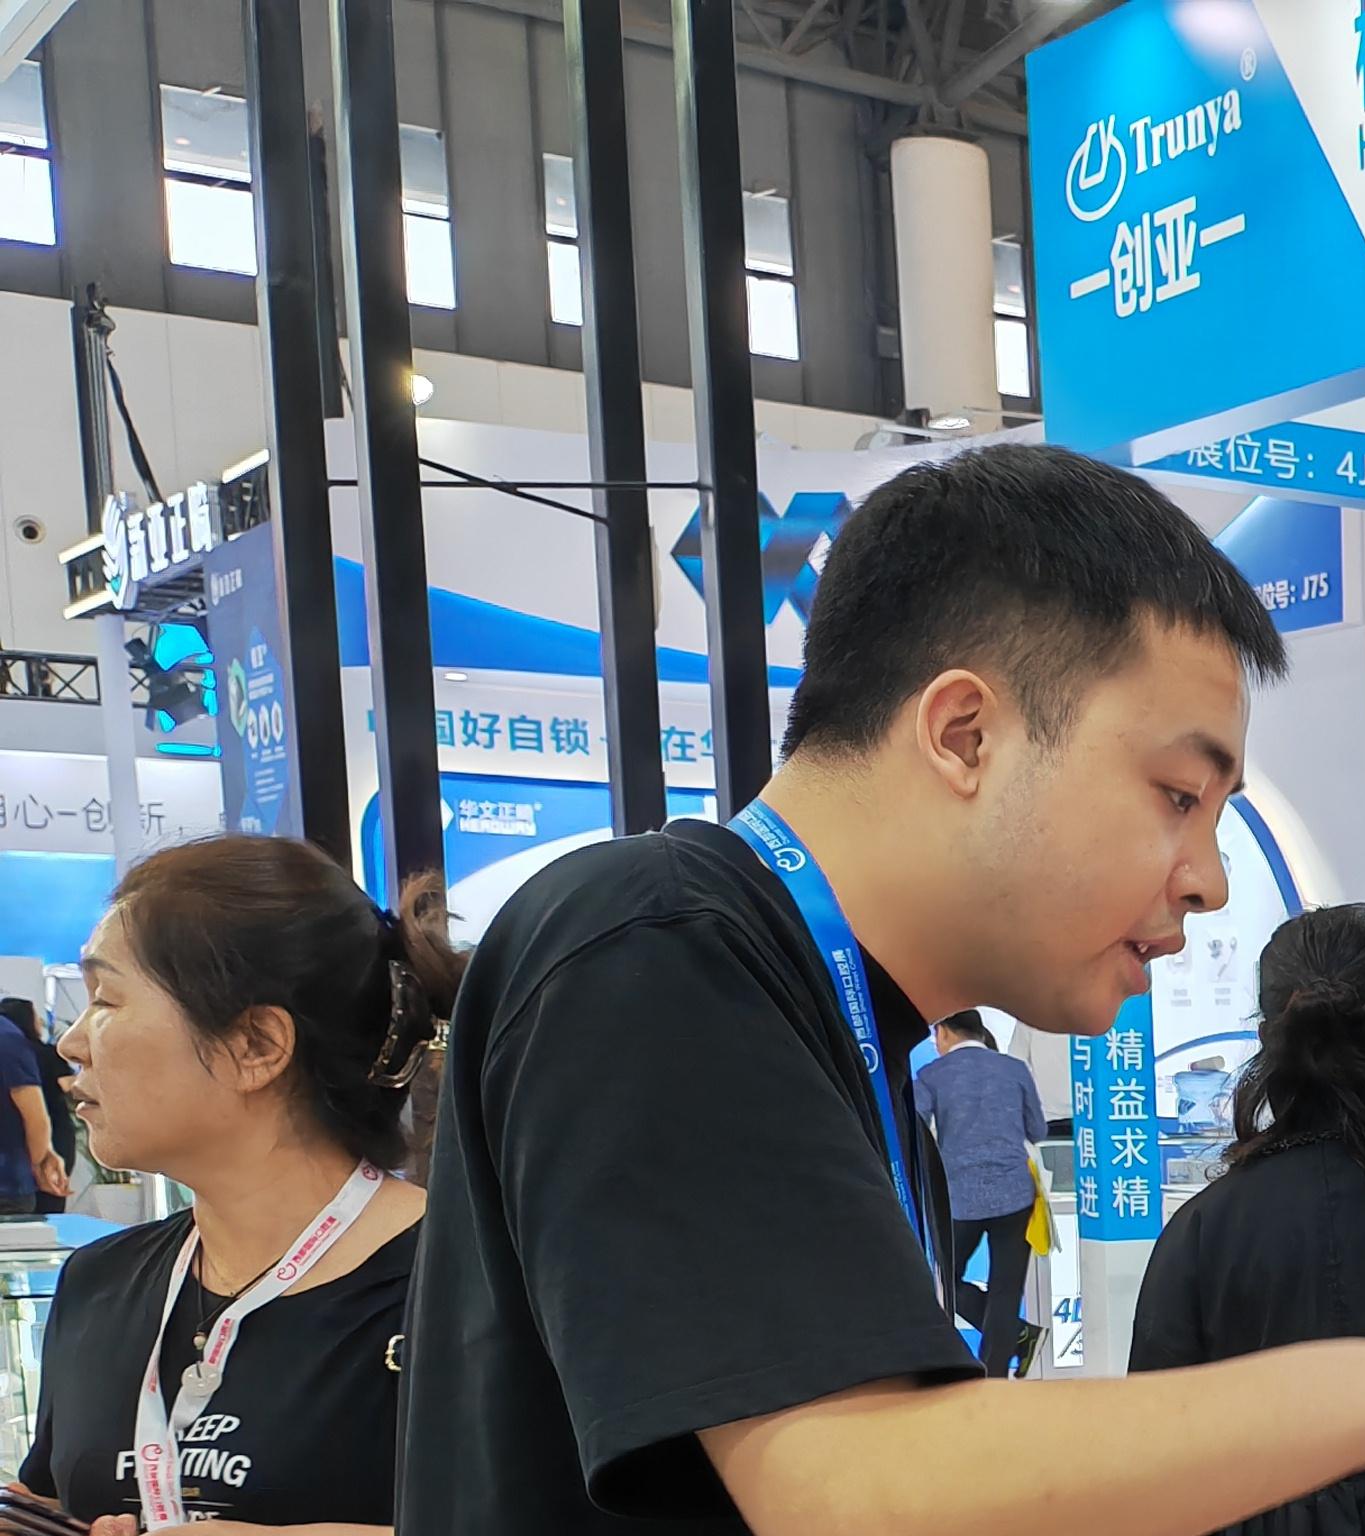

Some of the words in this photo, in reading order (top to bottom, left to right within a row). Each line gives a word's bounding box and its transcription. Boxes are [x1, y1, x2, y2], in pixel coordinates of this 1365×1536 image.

[1129, 88, 1242, 174] Trunya
[1301, 572, 1328, 600] J75
[1104, 1026, 1152, 1219] 精益求精
[177, 1413, 242, 1443] EEP
